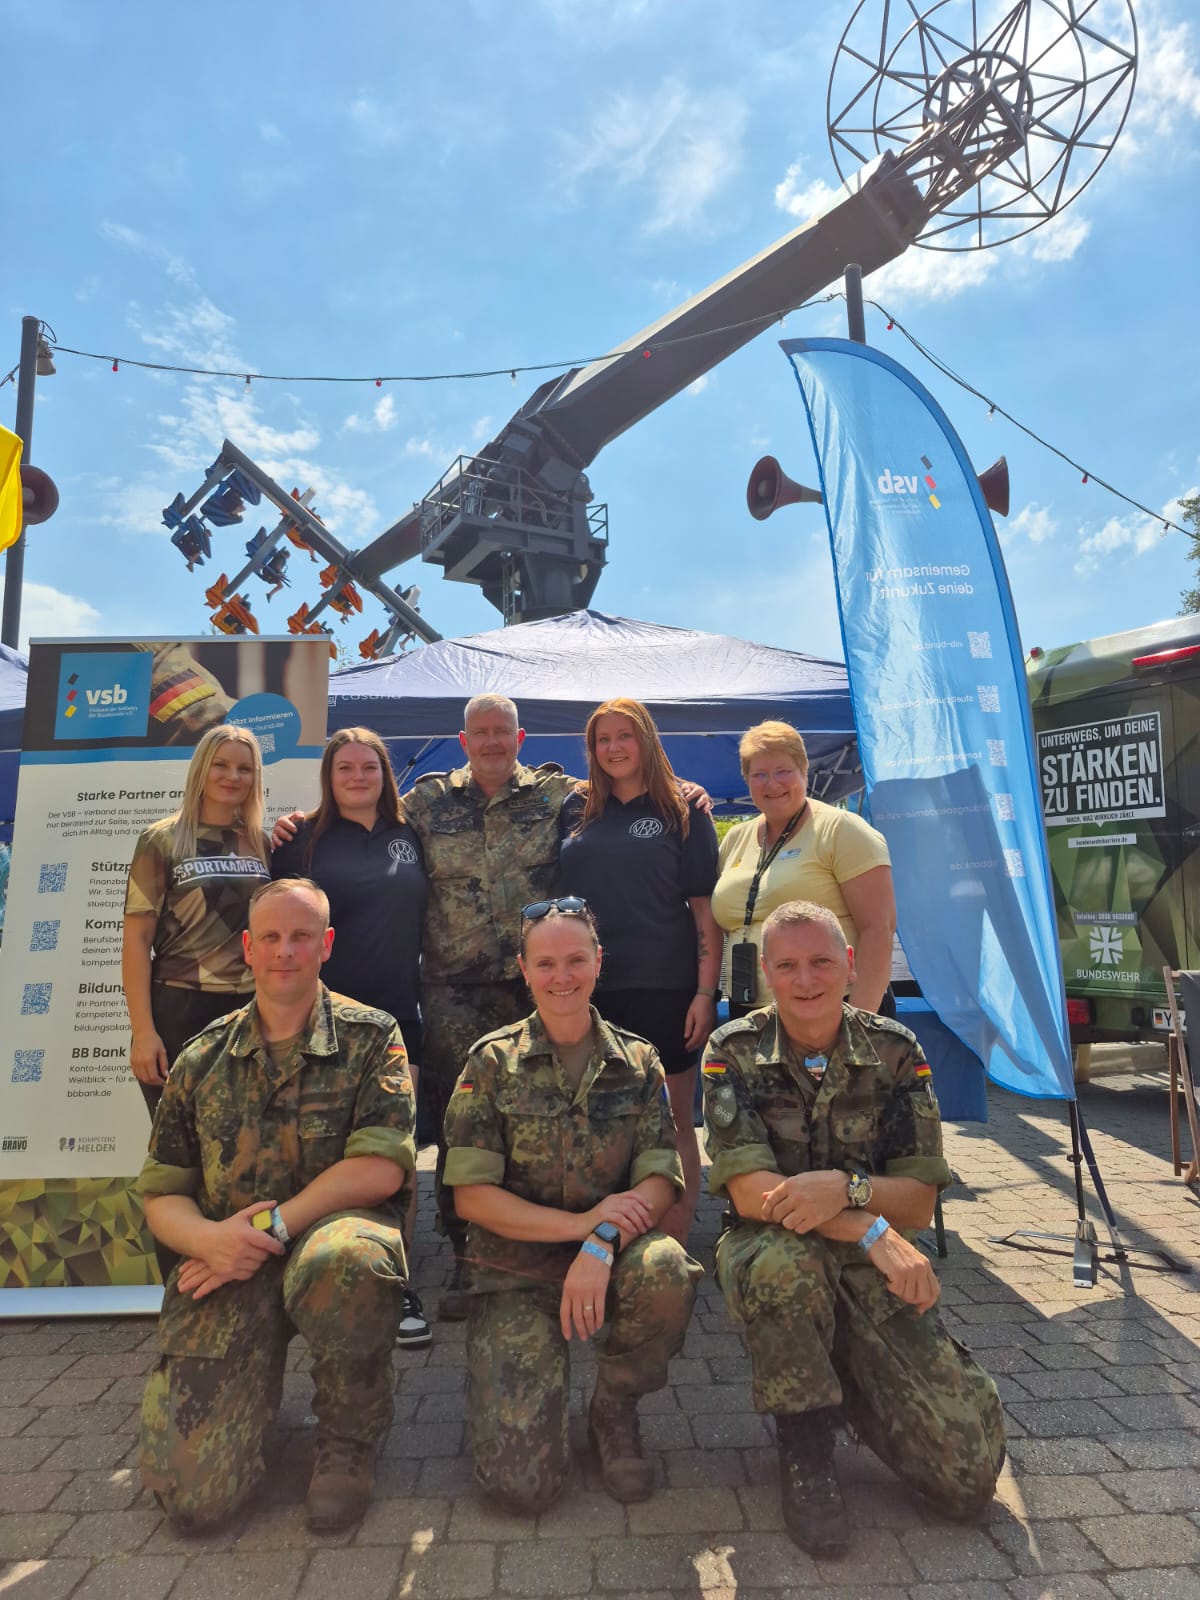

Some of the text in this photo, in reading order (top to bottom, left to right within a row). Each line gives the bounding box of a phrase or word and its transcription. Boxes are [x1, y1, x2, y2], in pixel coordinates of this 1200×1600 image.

[86, 684, 128, 705] vsb
[1041, 718, 1156, 749] UNTERWEGS, UM DEINE
[1042, 740, 1158, 786] STÄRKEN
[77, 789, 115, 801] Starke
[118, 789, 166, 800] Partner
[1044, 777, 1161, 814] ZU FINDEN.
[1076, 968, 1140, 983] BUNDESWEHR
[89, 1000, 119, 1008] Partner
[71, 1046, 127, 1059] BB Bank
[2, 1140, 28, 1150] BRAVO
[77, 1143, 116, 1152] HELDEN
